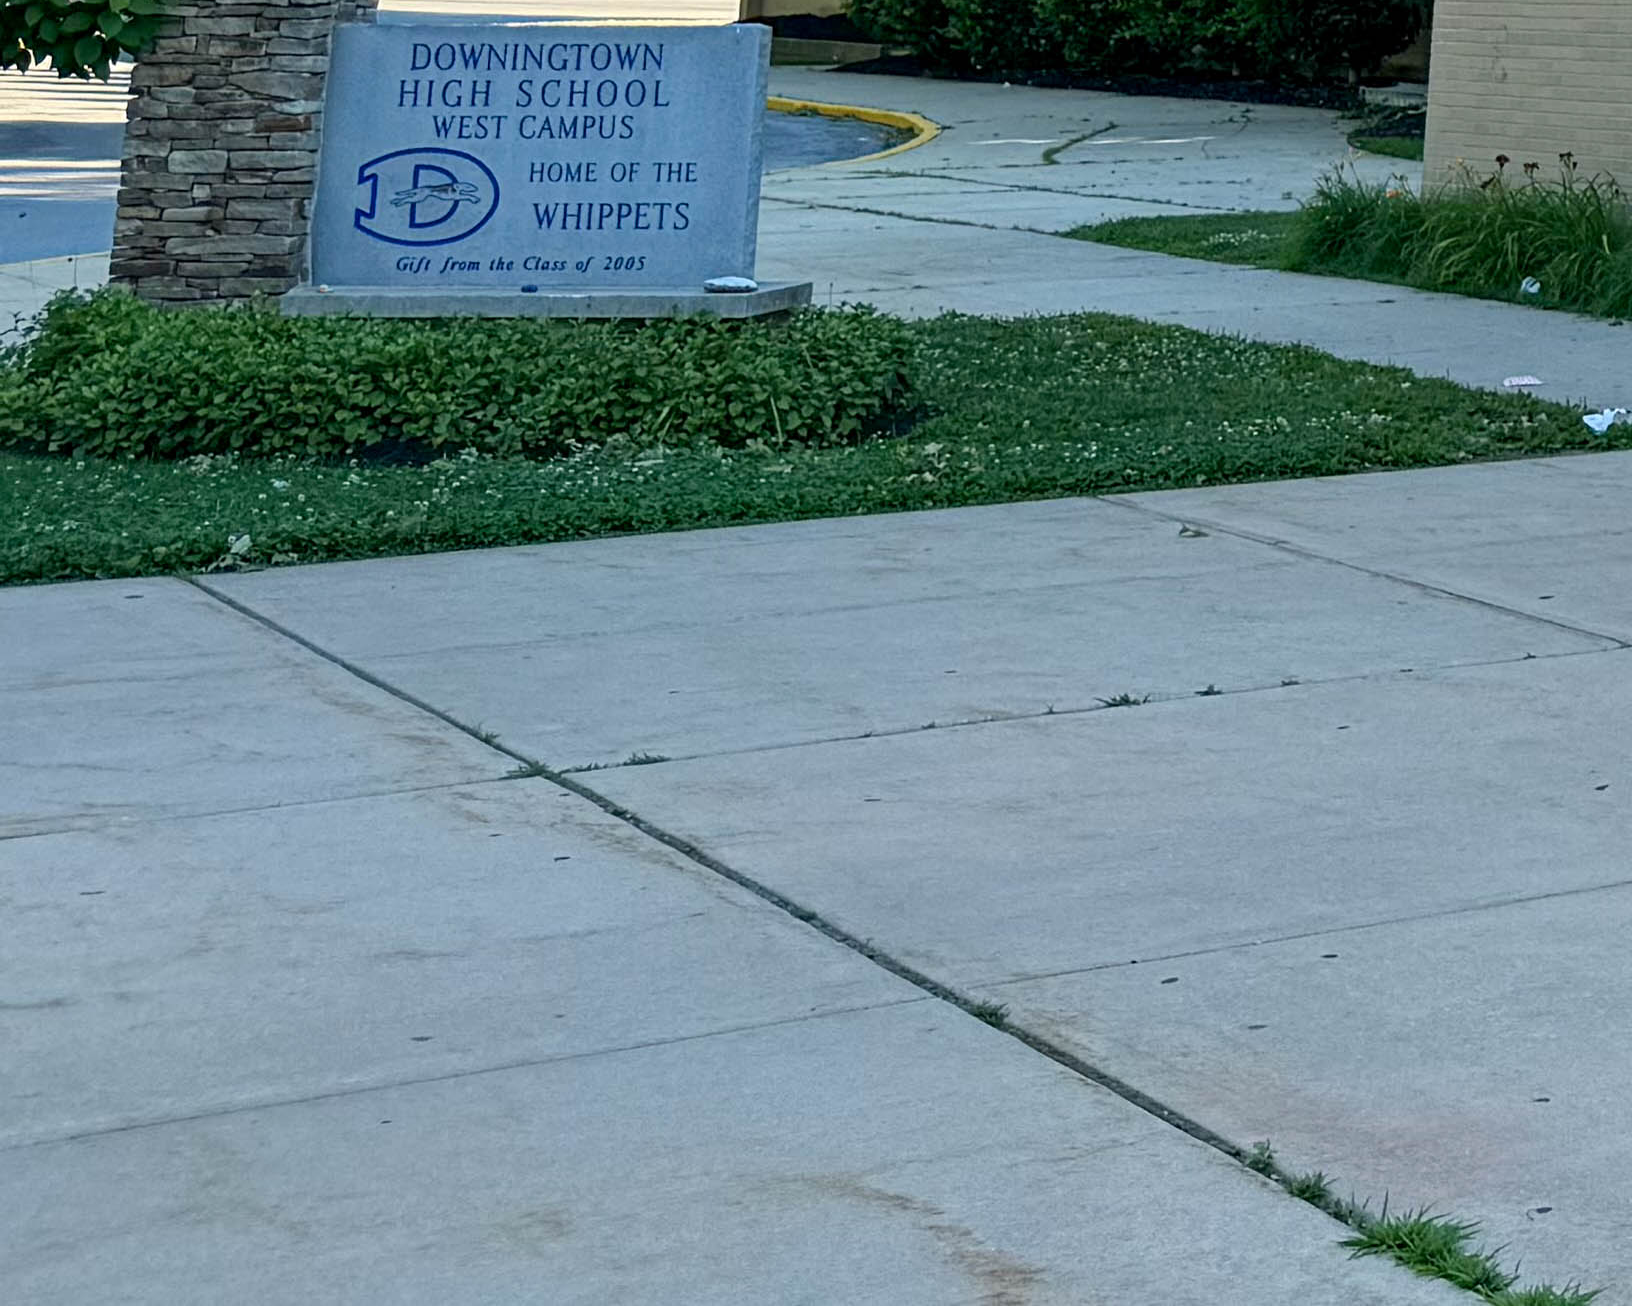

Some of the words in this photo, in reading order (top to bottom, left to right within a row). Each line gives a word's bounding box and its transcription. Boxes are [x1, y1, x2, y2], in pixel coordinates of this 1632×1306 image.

[410, 43, 665, 71] DOWNINGTOWN
[398, 79, 492, 108] HIGH
[516, 79, 671, 108] SCHOOL
[432, 115, 508, 139] WEST
[519, 115, 635, 140] CAMPUS
[529, 162, 598, 183] HOME
[611, 162, 641, 183] OF
[653, 162, 698, 183] THE
[532, 202, 690, 230] WHIPPETS
[396, 255, 431, 273] Gift
[438, 256, 481, 272] from
[489, 256, 514, 272] the
[523, 255, 566, 271] Class
[575, 255, 594, 273] of
[603, 255, 647, 271] 2005
